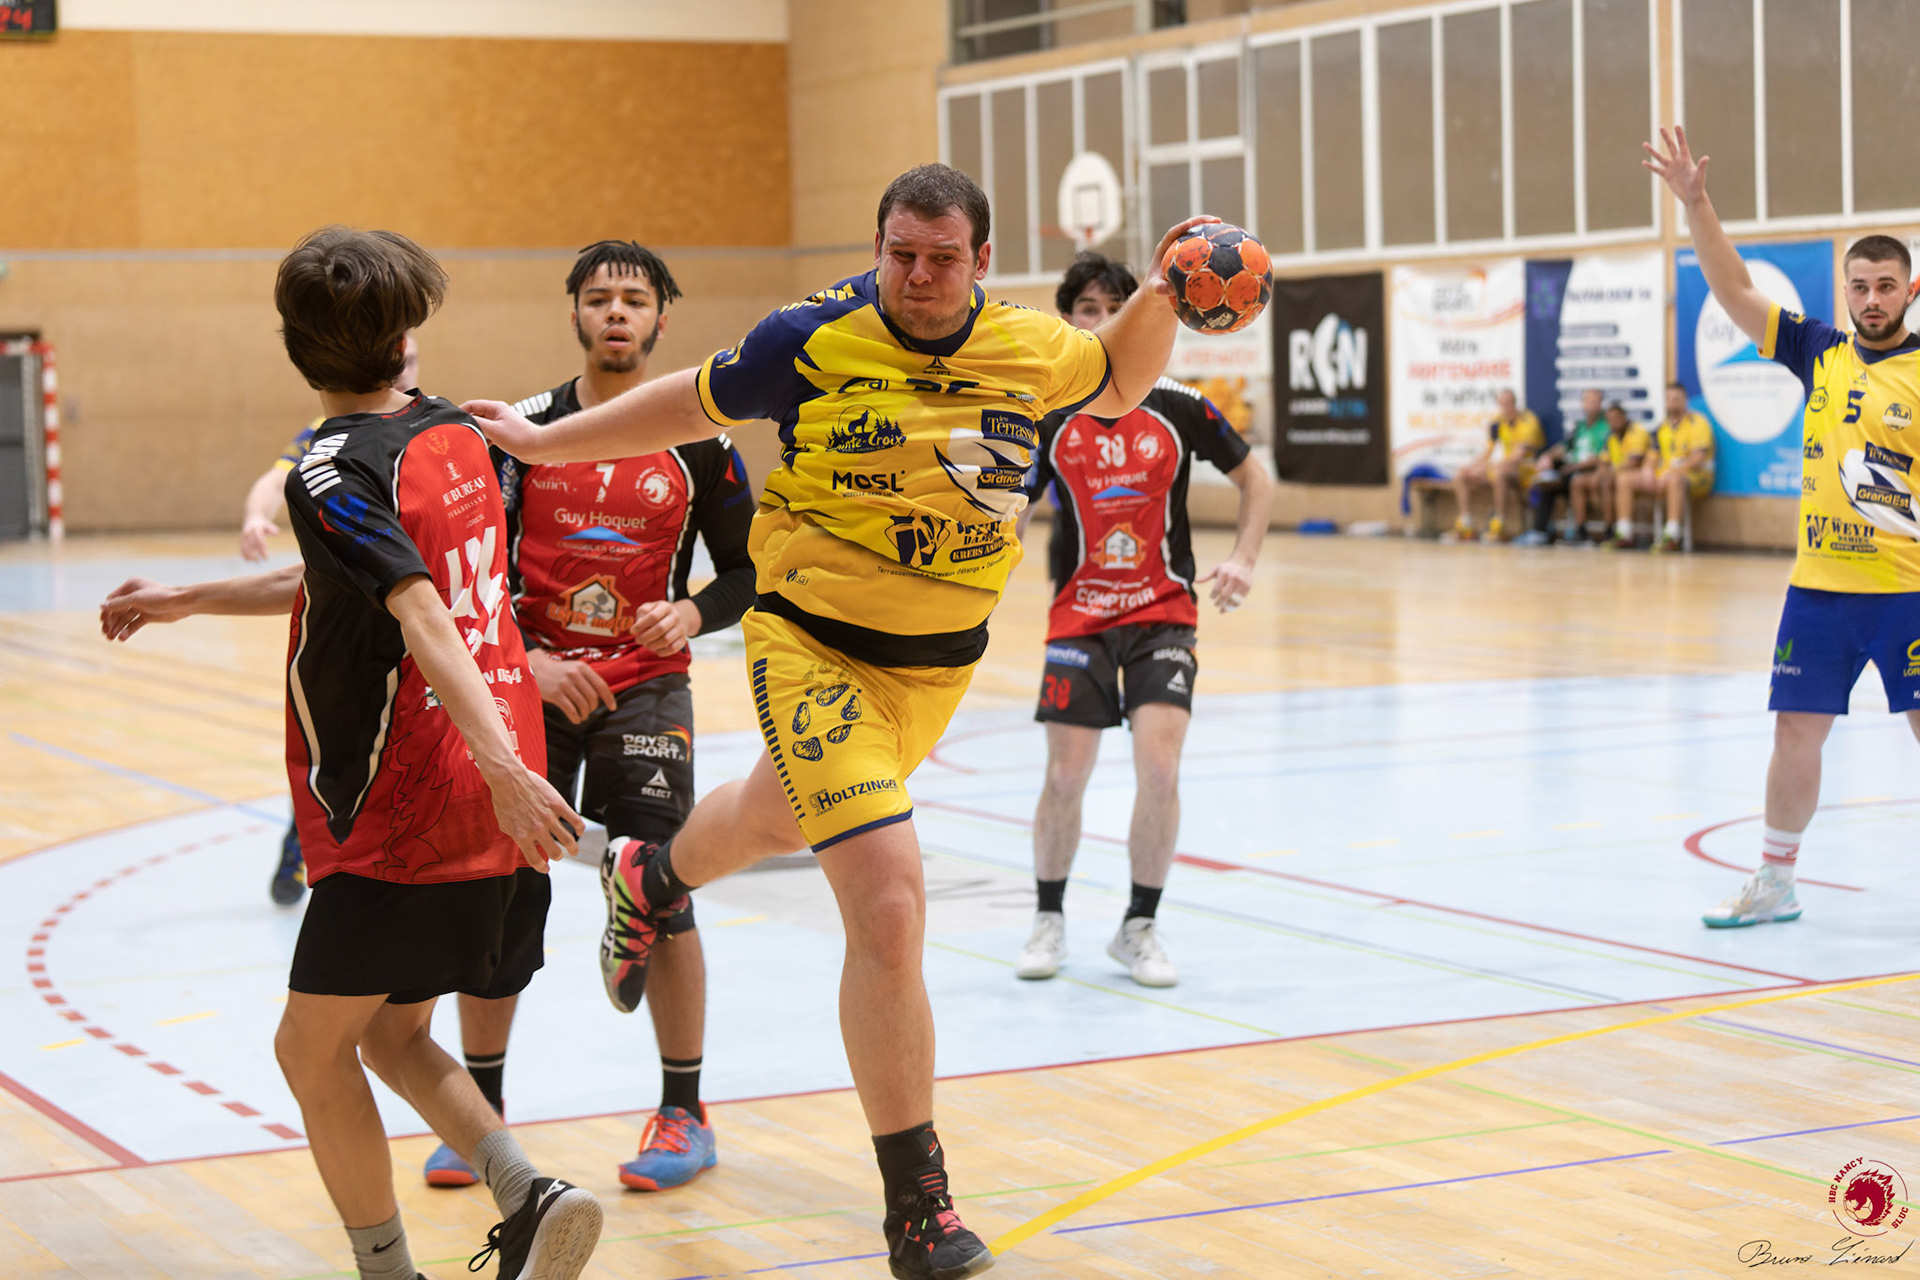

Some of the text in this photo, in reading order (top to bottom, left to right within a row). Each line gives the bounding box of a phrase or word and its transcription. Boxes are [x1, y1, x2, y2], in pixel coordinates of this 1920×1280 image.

[1842, 390, 1866, 424] 5
[1095, 433, 1126, 469] 38
[595, 463, 616, 502] 7
[554, 508, 648, 530] Guy Hoquet
[1831, 521, 1875, 538] WEYH
[952, 547, 984, 561] KREBS
[1075, 586, 1157, 610] COMPTOIR
[1040, 674, 1071, 710] 38
[640, 787, 672, 799] SELECT
